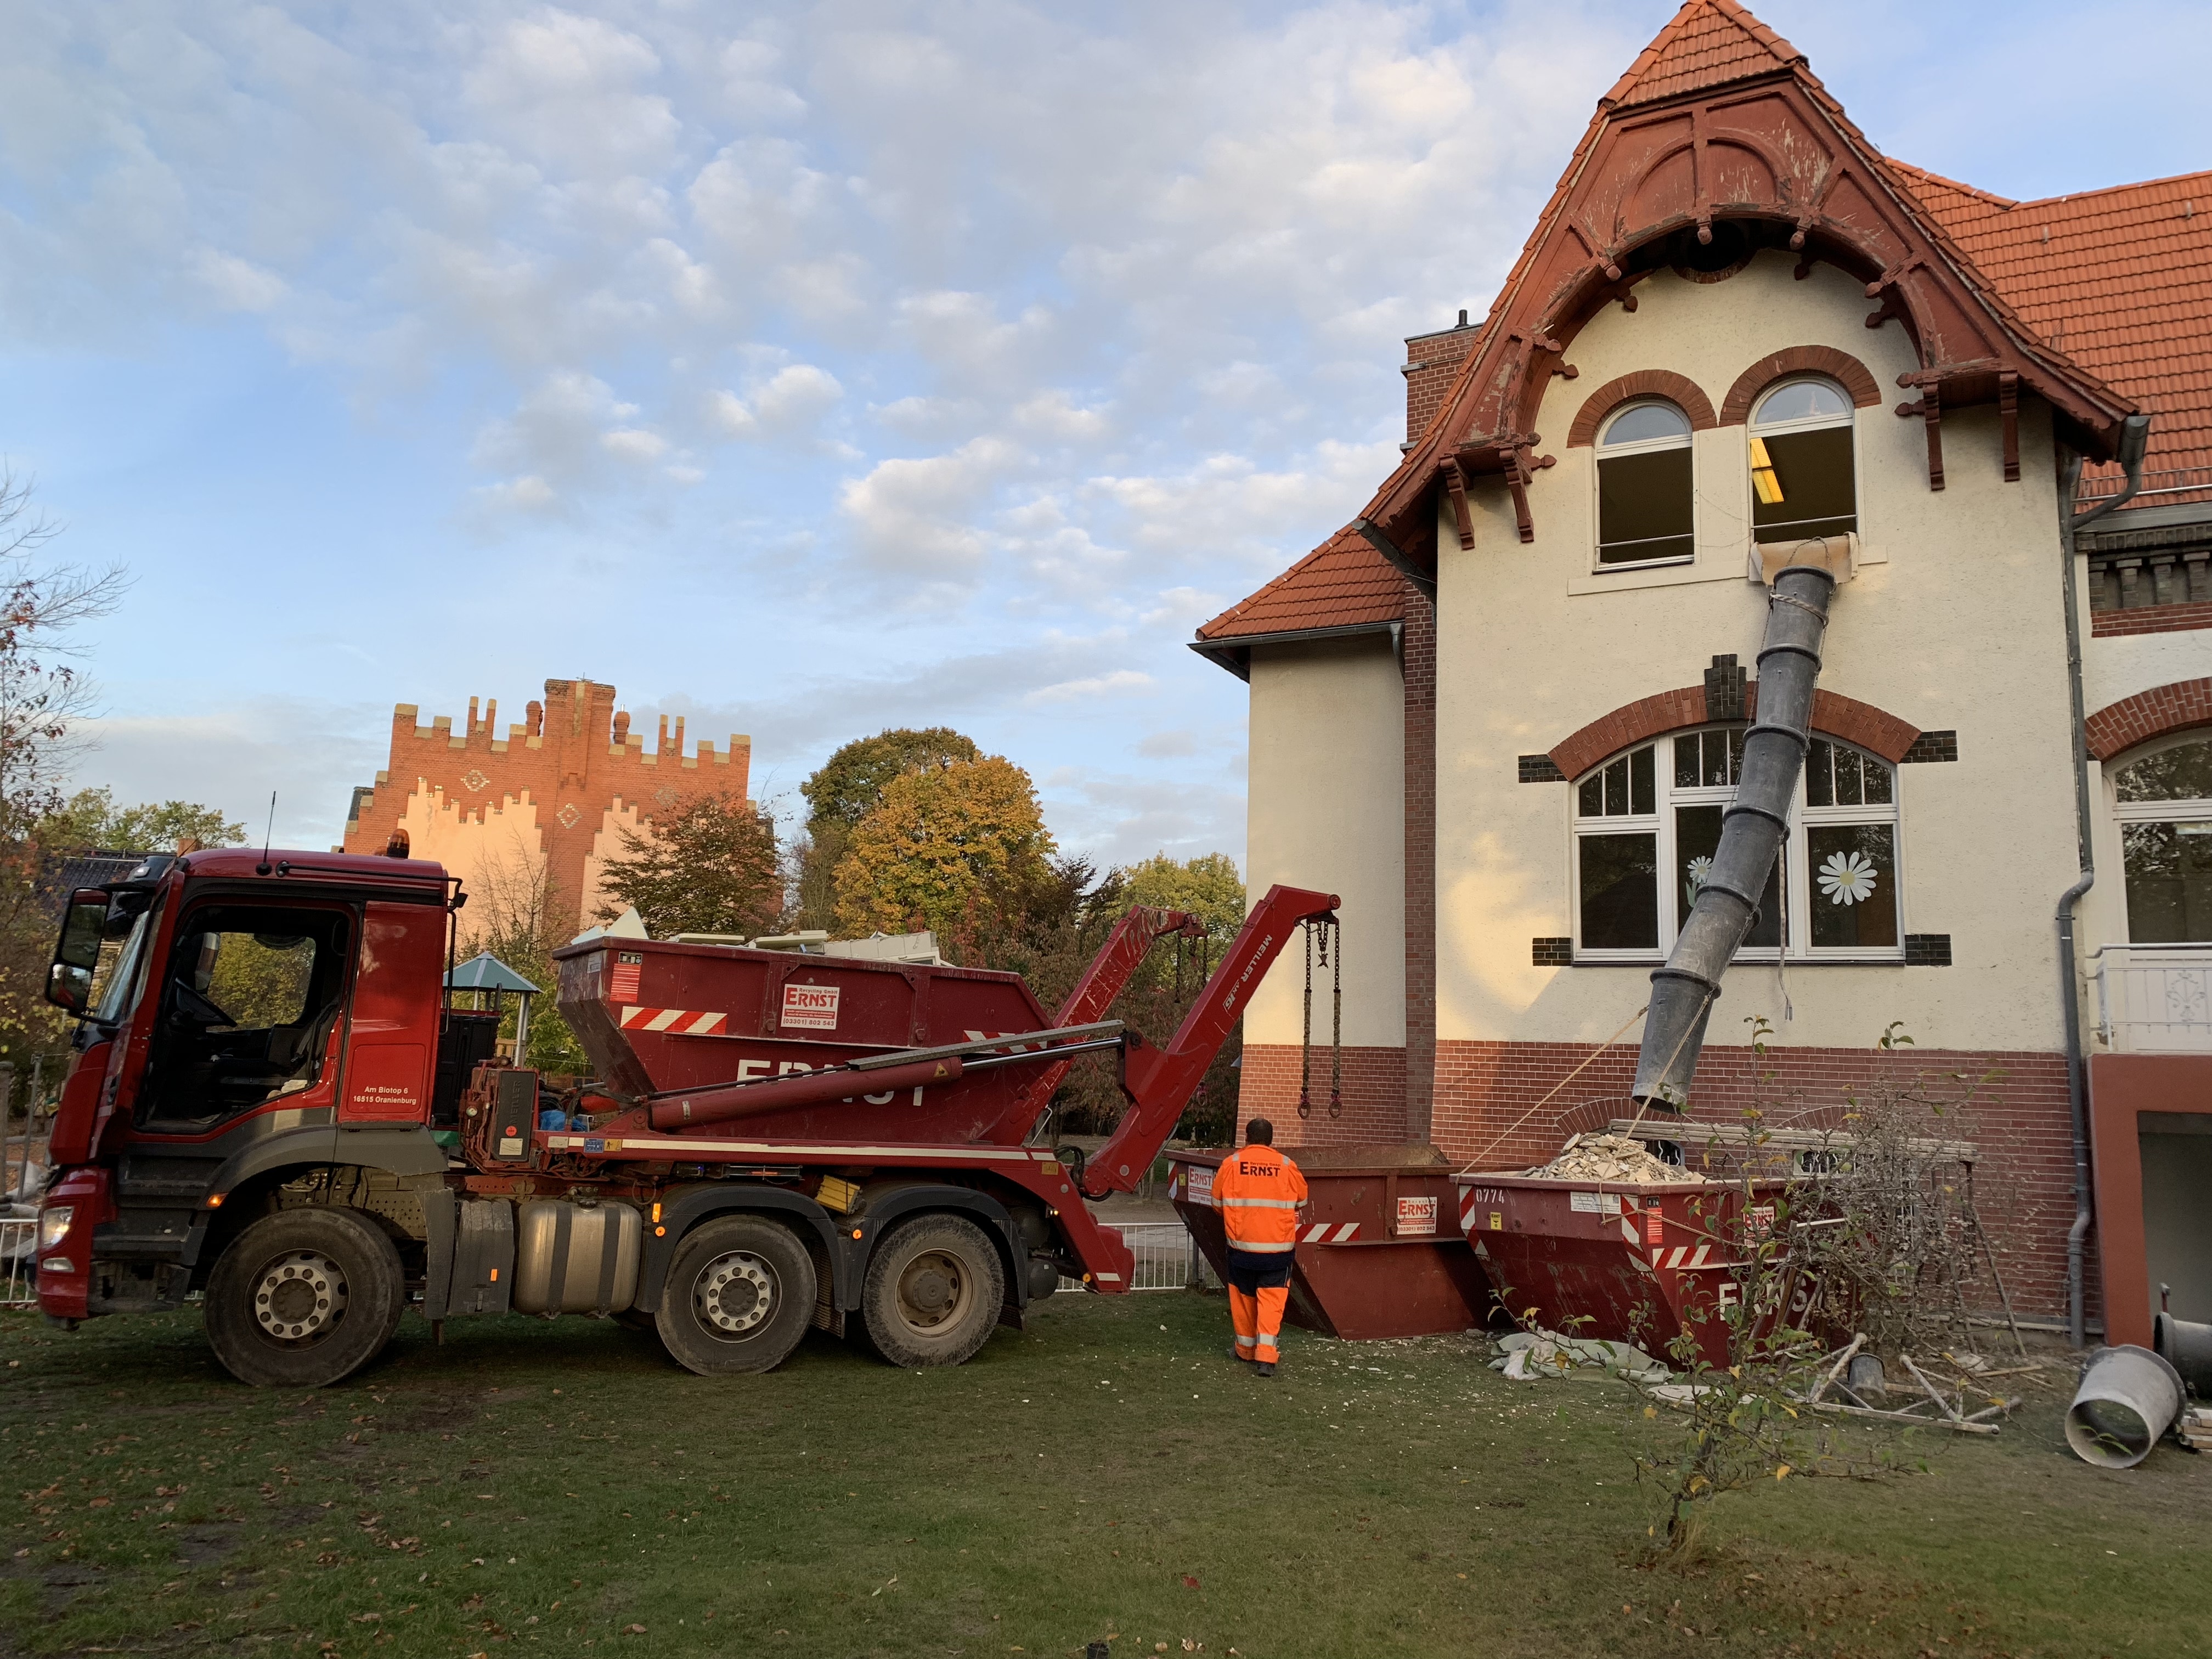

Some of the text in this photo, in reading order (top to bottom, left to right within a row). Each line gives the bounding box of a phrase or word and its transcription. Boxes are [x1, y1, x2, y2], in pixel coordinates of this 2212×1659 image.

[1240, 934, 1273, 982] MEILLER
[785, 988, 837, 1007] ERNST
[378, 1086, 402, 1095] Biotop
[375, 1096, 416, 1105] Oranienburg
[510, 1080, 521, 1125] MEILLER
[1189, 1168, 1212, 1187] ERNST
[1240, 1161, 1280, 1177] ERNST
[1398, 1200, 1436, 1216] ERNST
